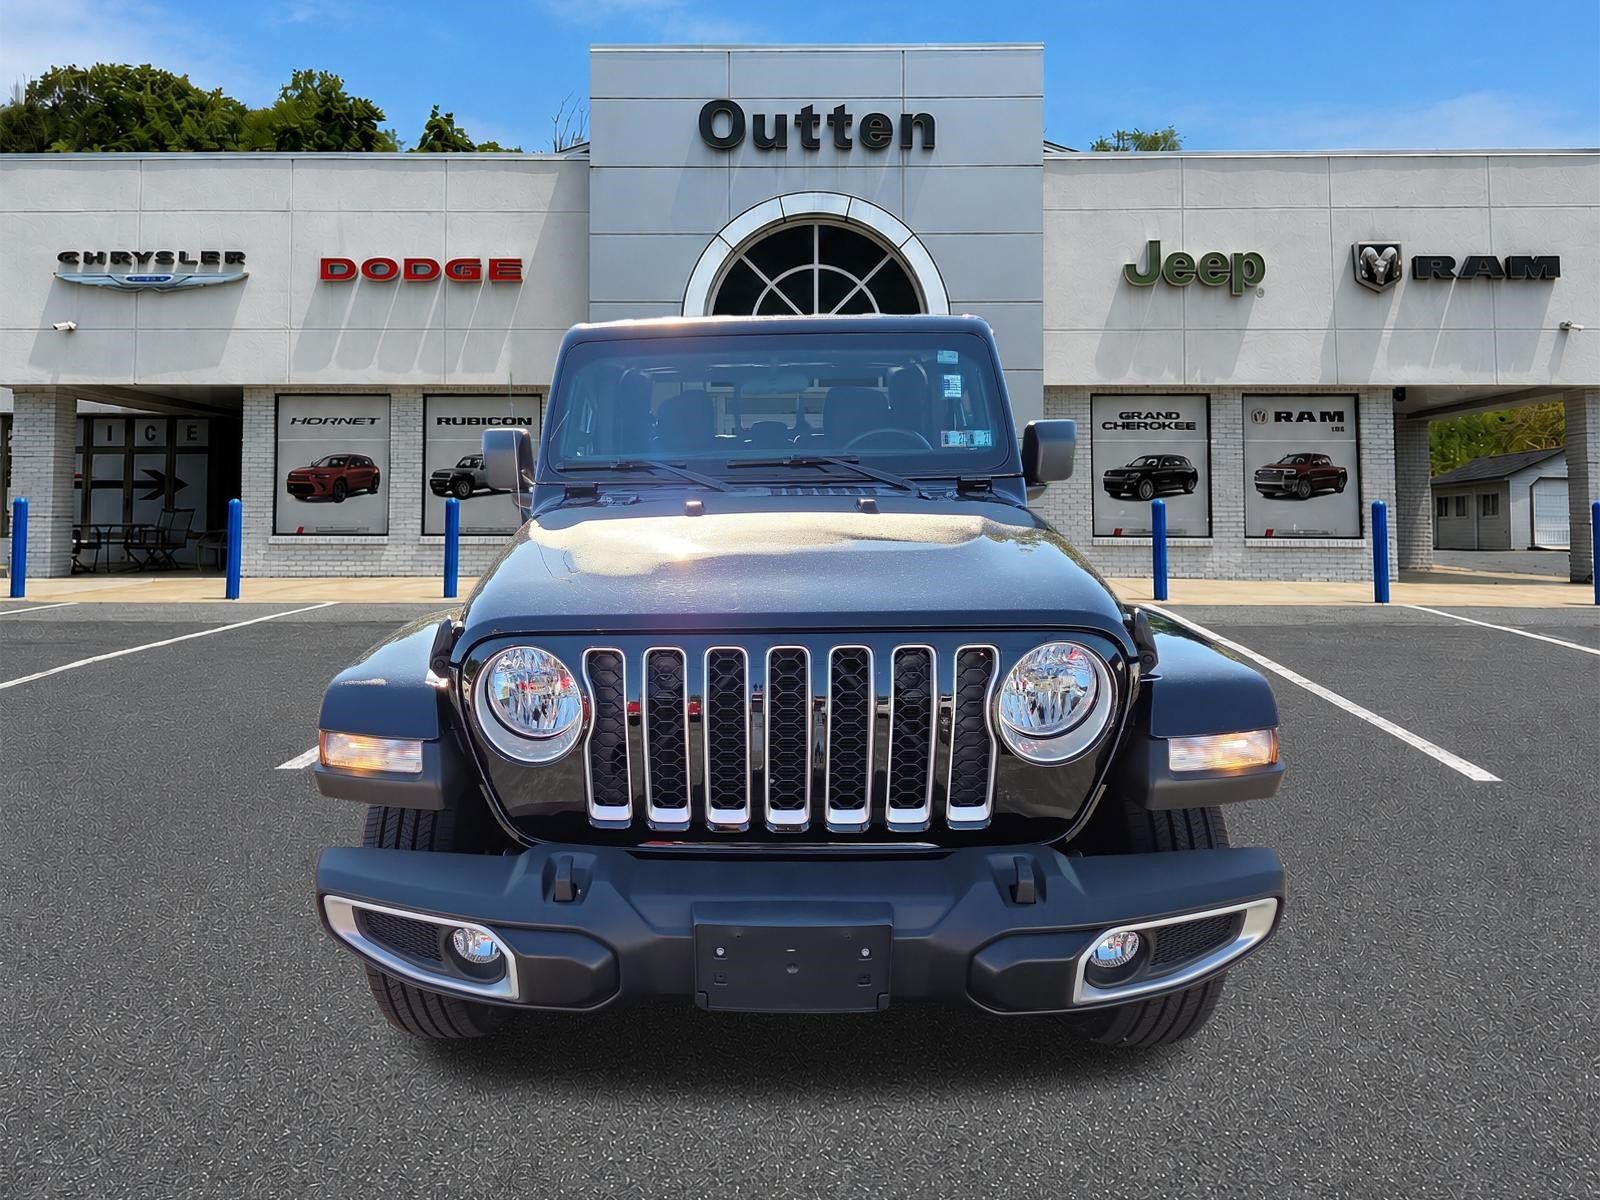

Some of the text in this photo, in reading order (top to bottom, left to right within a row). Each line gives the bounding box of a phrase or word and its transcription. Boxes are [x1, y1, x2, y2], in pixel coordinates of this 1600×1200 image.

[698, 99, 936, 150] Outten
[57, 250, 247, 266] CHRYSLER
[320, 257, 524, 283] DODGE
[1123, 240, 1266, 296] Jeep
[1411, 255, 1561, 280] RAM
[290, 417, 381, 426] HORNET
[436, 416, 533, 426] RUBICON
[1118, 411, 1181, 421] GRAND
[1274, 411, 1345, 423] RAM
[1101, 421, 1197, 431] CHEROKEE
